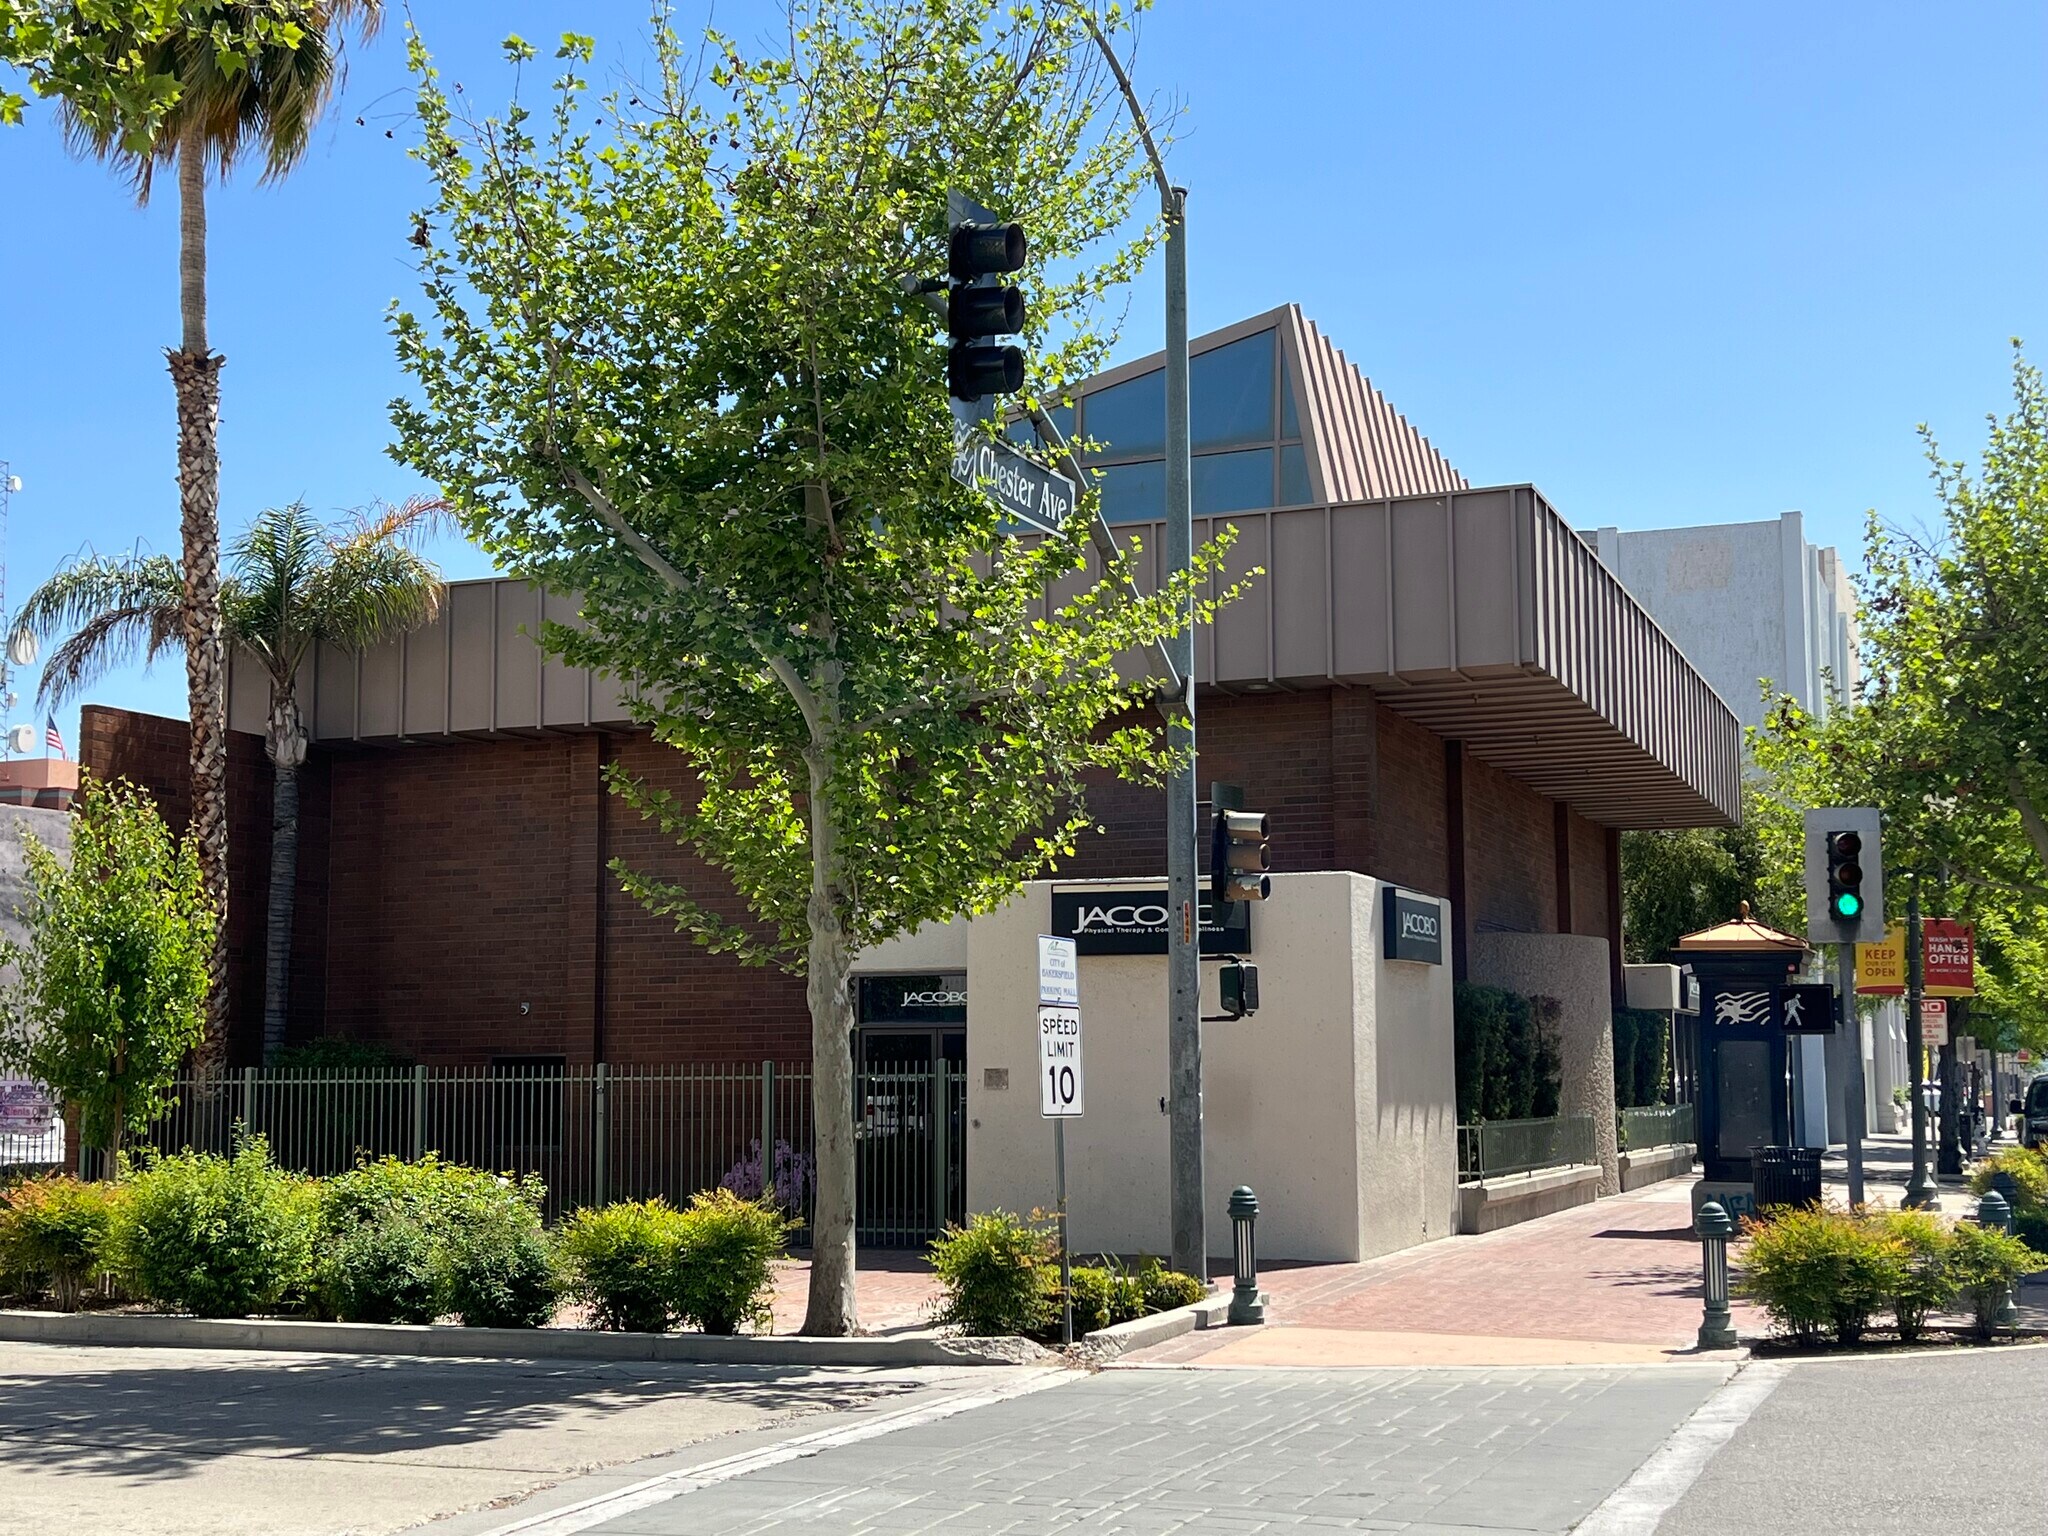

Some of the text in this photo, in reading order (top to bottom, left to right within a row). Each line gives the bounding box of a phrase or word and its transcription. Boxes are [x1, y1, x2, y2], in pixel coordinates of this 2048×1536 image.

[980, 446, 1068, 526] Chester Ave
[1072, 905, 1212, 934] JACO
[1402, 911, 1437, 937] JACOBO
[1865, 949, 1896, 960] KEEP
[1929, 954, 1969, 965] OFTEN
[1865, 967, 1896, 977] OPEN
[1043, 1018, 1078, 1035] SPEED
[1047, 1041, 1074, 1058] LIMIT
[1049, 1065, 1075, 1105] 10
